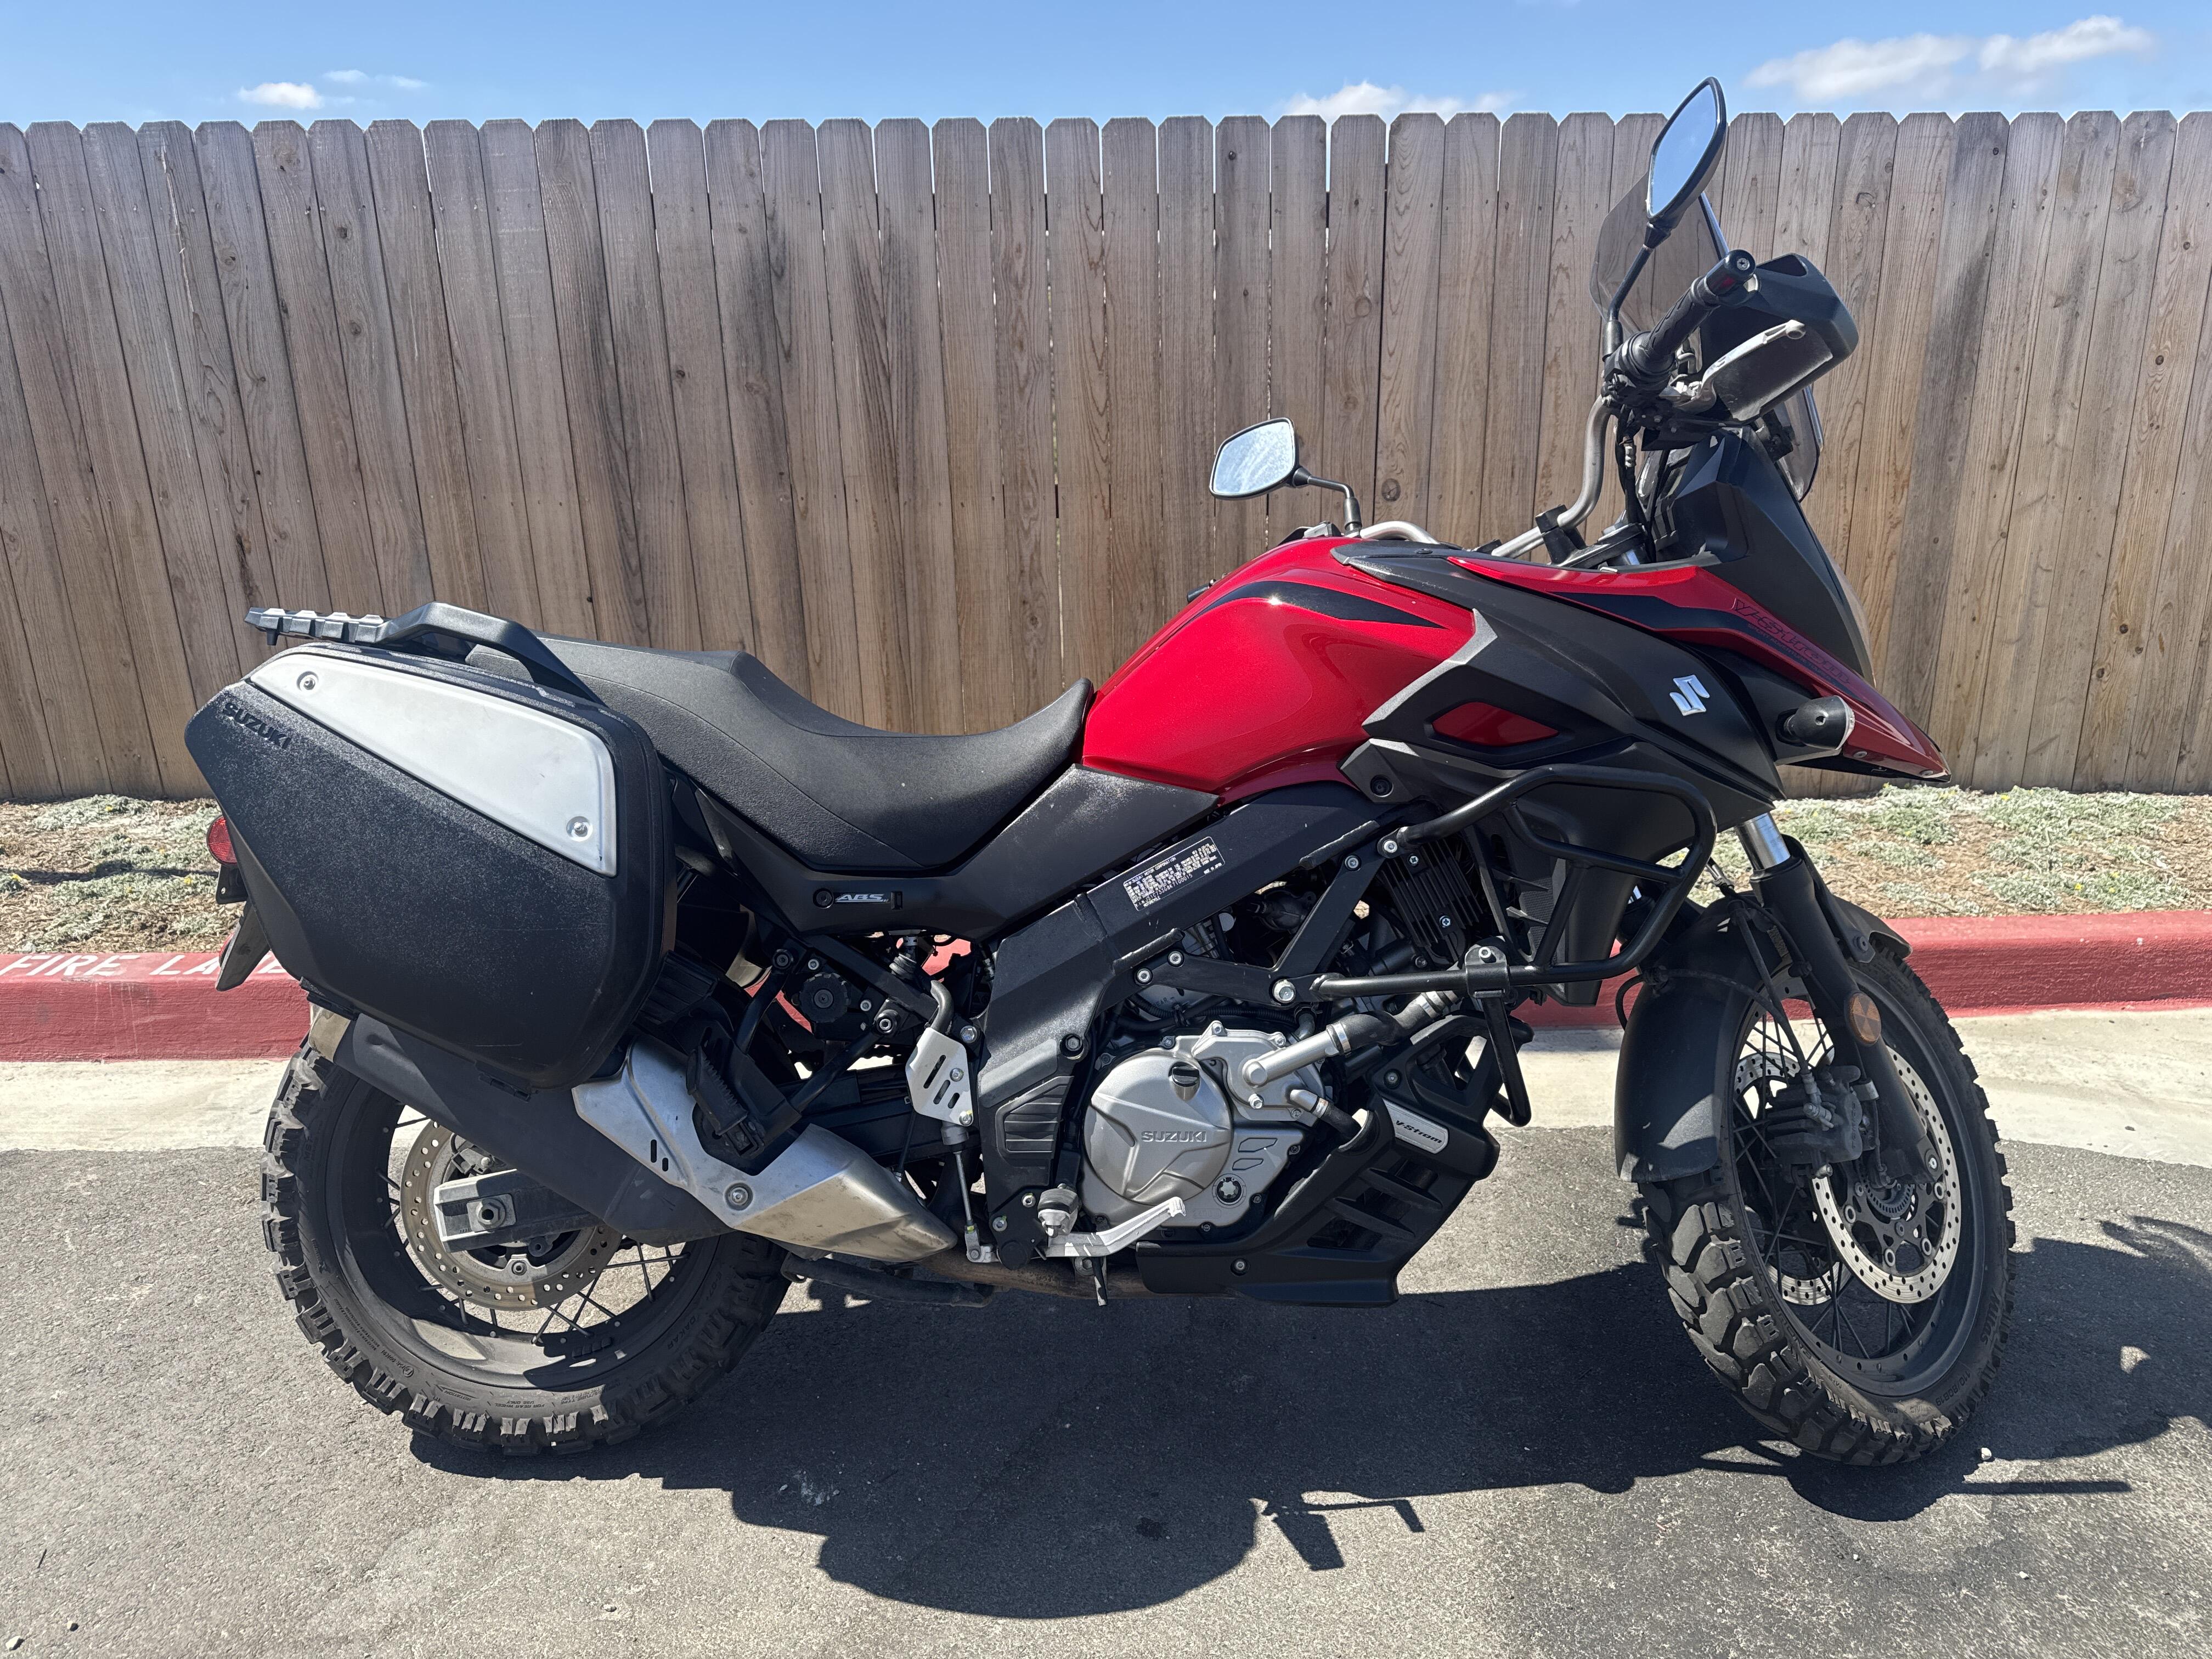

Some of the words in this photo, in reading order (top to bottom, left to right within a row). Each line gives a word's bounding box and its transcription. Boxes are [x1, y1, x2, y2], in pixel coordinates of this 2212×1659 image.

[223, 703, 292, 749] SUZUKI
[0, 954, 140, 977] FIRE
[149, 955, 287, 975] LAE
[1141, 1131, 1207, 1142] SUZUKI
[1396, 1120, 1442, 1143] V-Strom
[444, 1390, 472, 1401] ROTATION
[1936, 1371, 1971, 1407] 110/80B19
